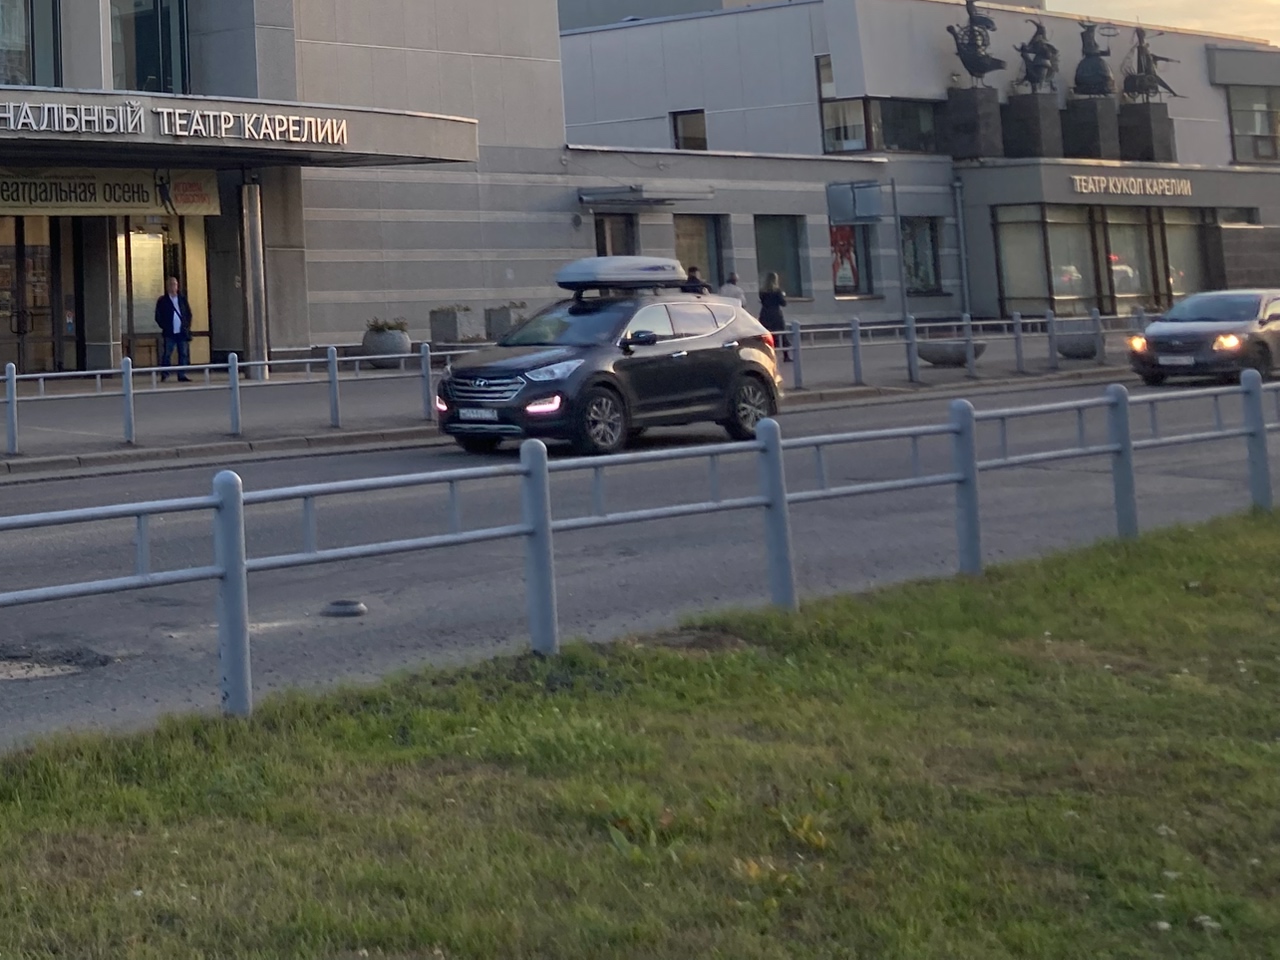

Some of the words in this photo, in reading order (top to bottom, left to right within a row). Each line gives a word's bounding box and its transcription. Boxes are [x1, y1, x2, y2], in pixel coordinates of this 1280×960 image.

[154, 107, 234, 138] ТЕАТР
[243, 113, 348, 144] КАРЕЛИИ
[103, 182, 150, 203] осень
[1072, 175, 1107, 193] ТЕАТР
[1109, 176, 1144, 195] КУКОЛ
[1146, 178, 1192, 196] КАРЕЛИИ
